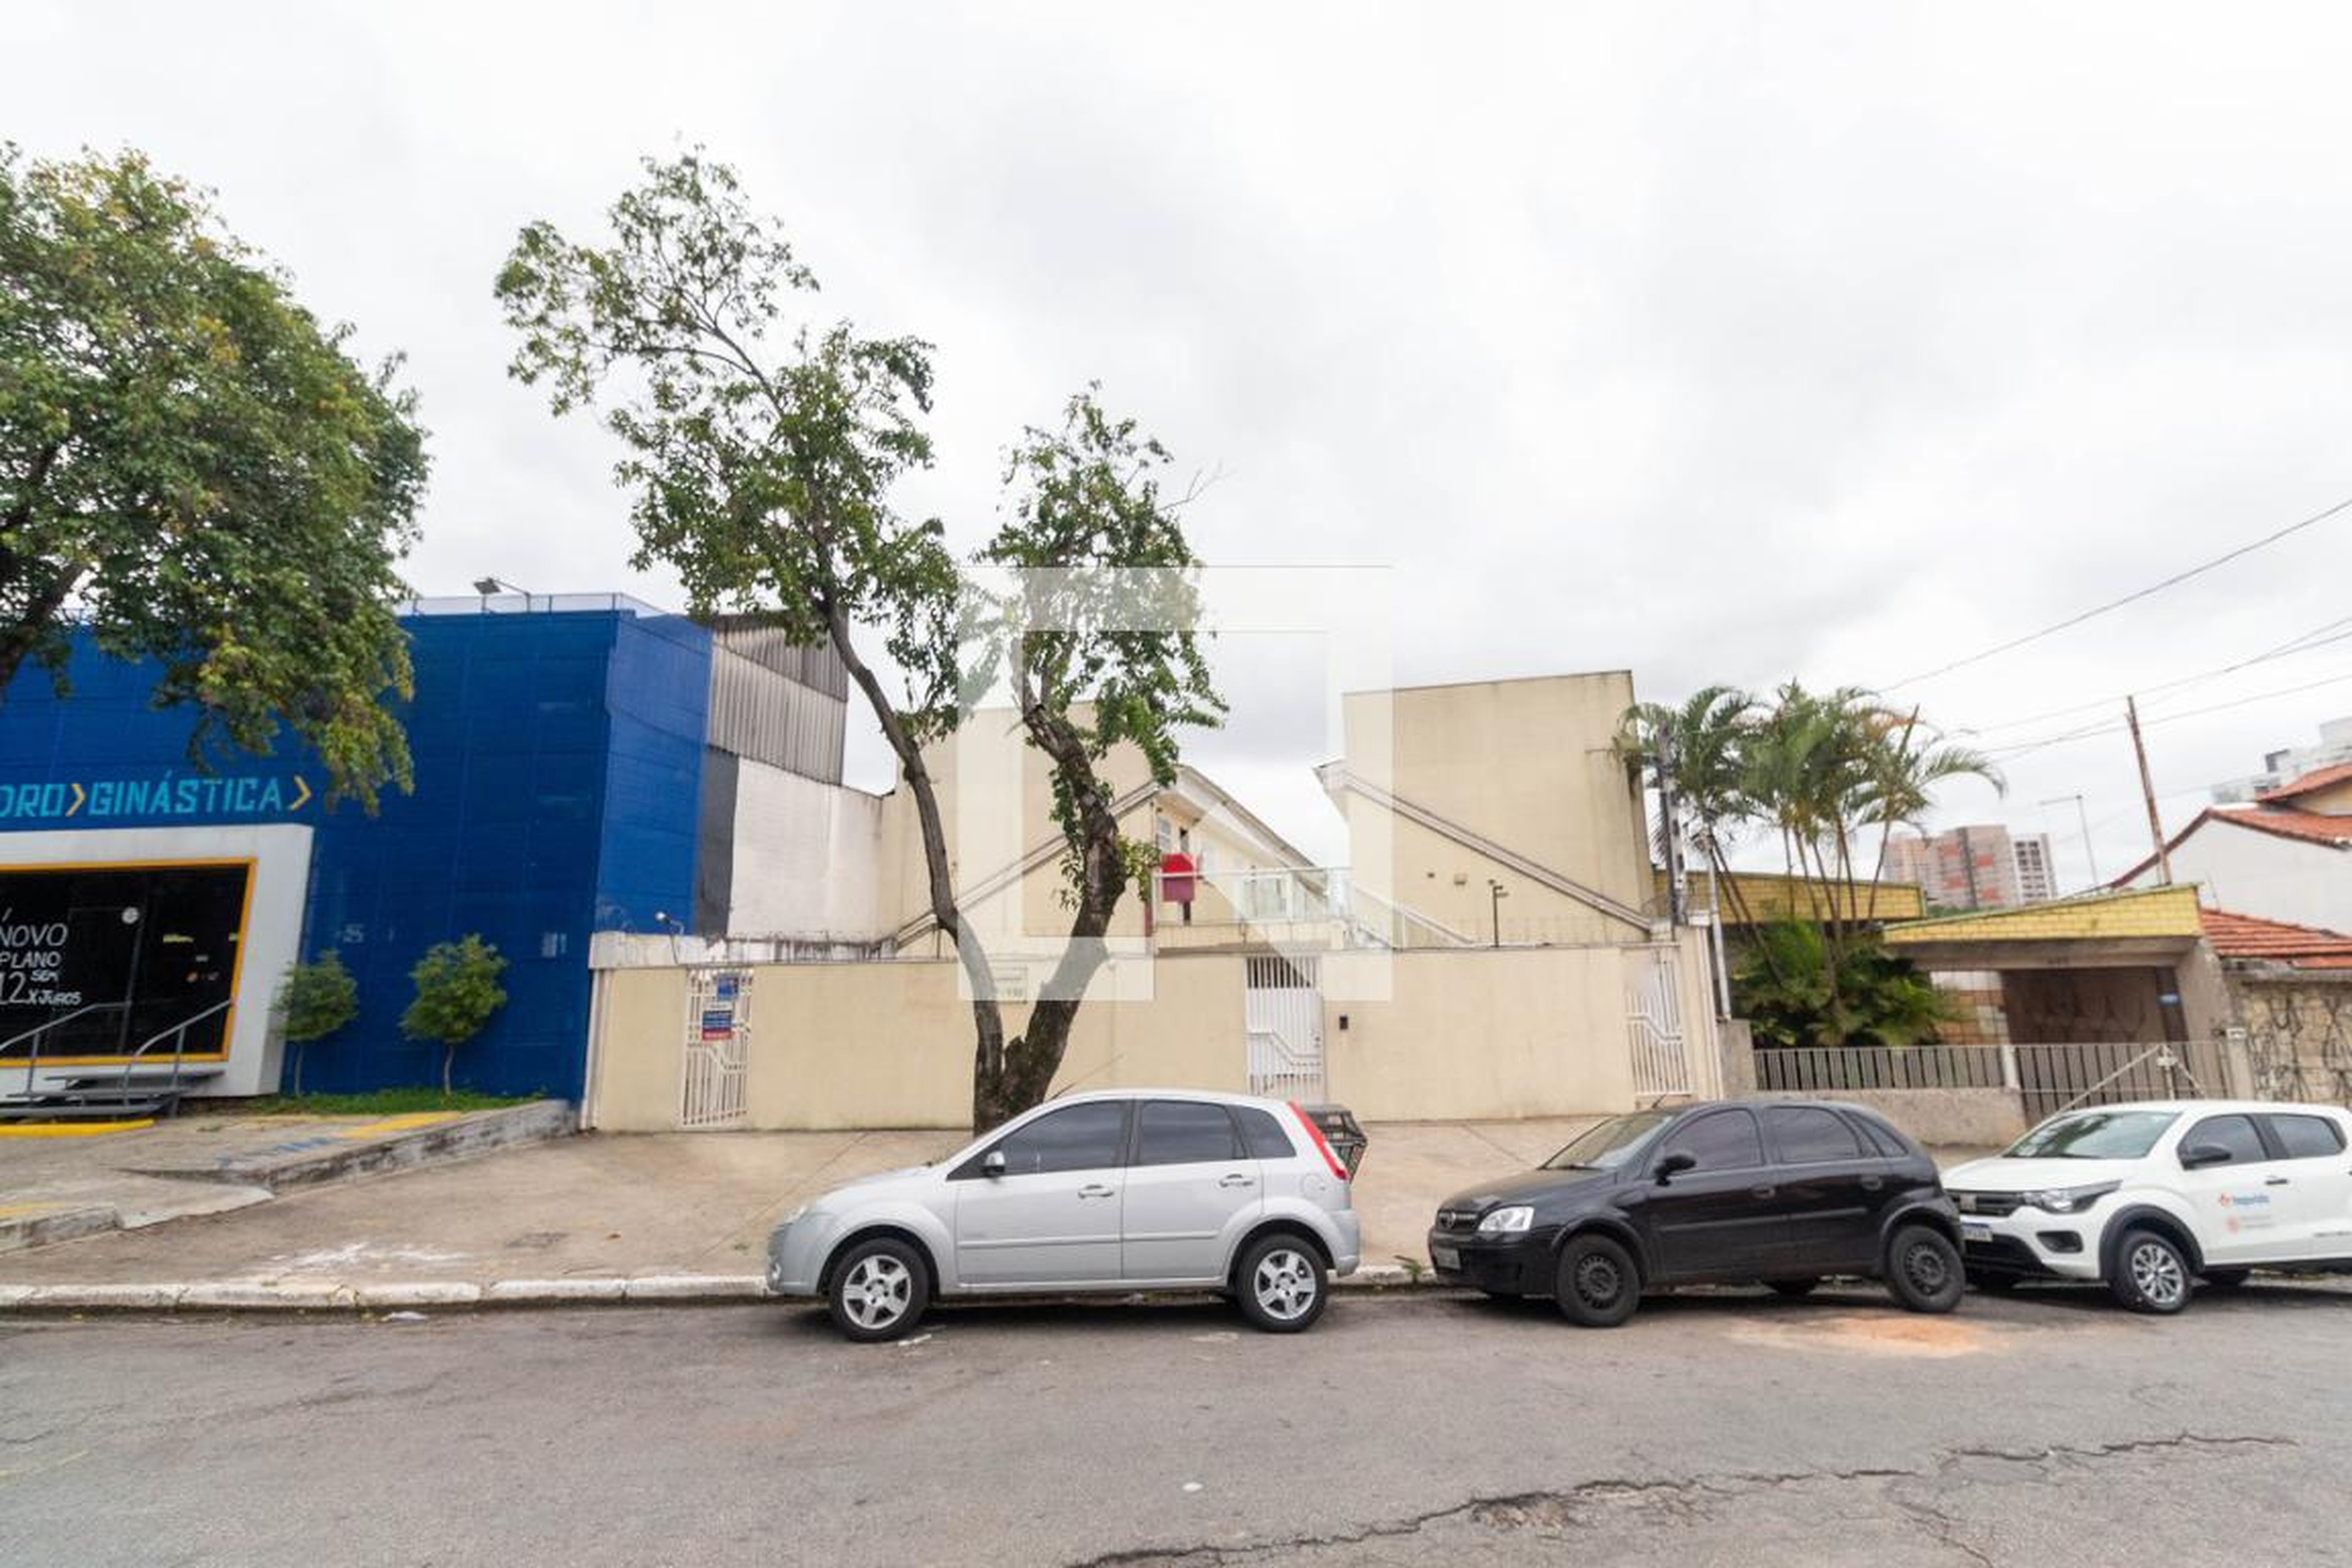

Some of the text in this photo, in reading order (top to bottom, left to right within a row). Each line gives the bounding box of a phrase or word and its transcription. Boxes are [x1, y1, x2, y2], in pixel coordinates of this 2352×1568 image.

[89, 769, 281, 815] GINÁSTICA
[0, 923, 68, 947] NOVO
[0, 951, 61, 969] PLANO
